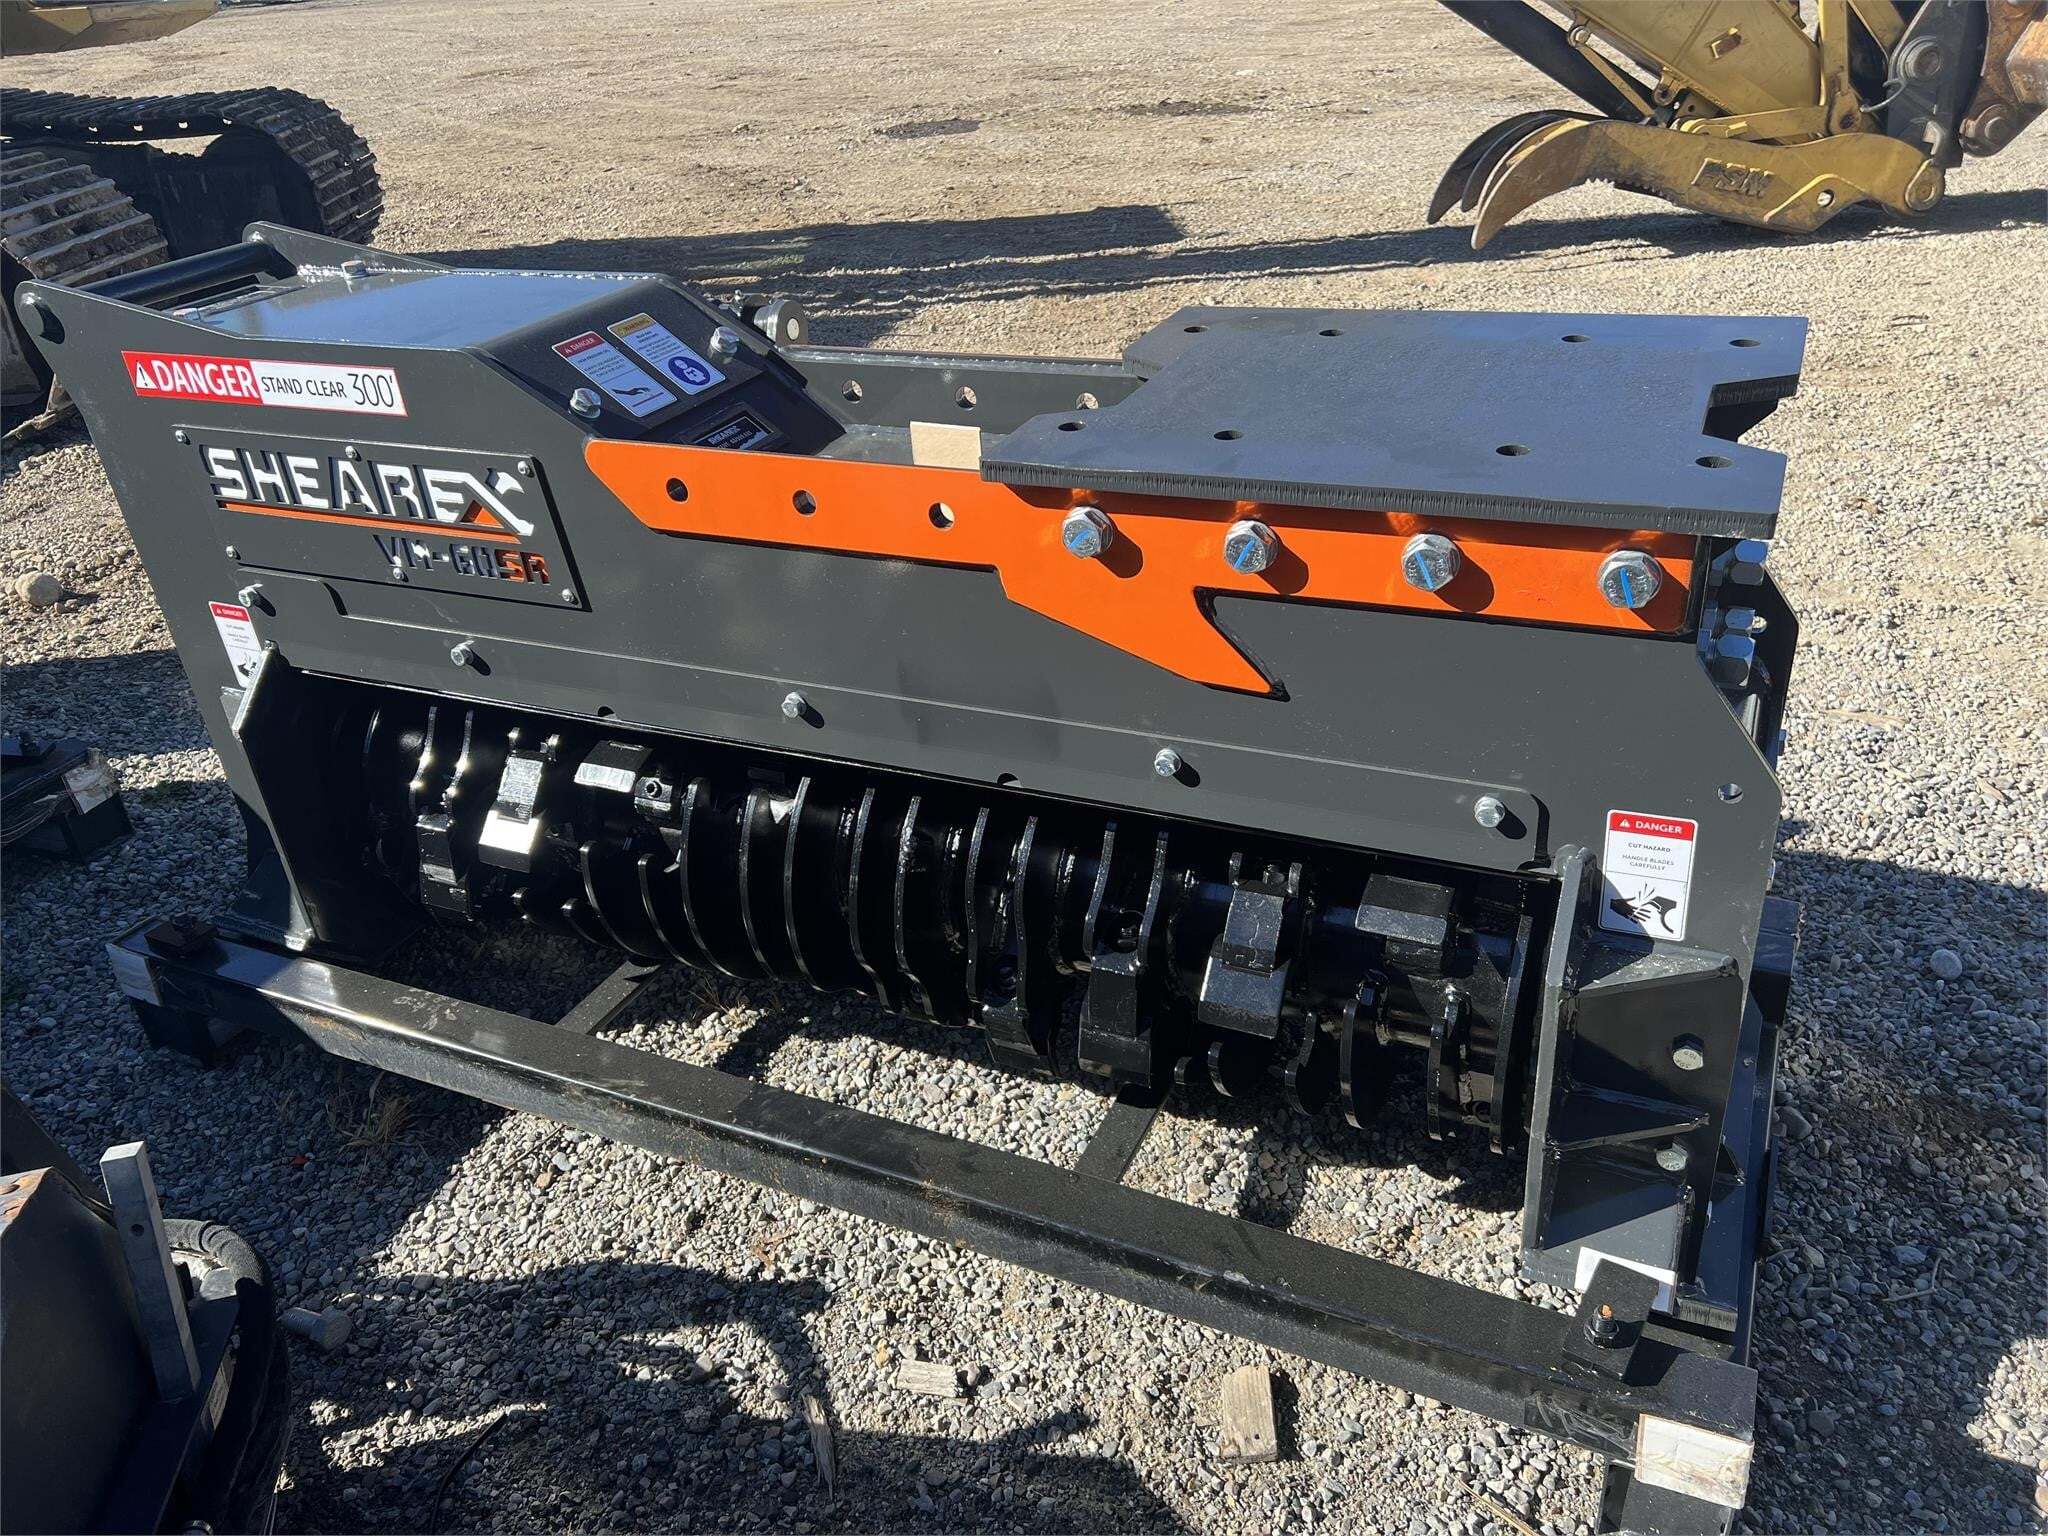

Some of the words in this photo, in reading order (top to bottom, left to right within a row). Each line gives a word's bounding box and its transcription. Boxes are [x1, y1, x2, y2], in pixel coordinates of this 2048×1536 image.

[154, 360, 259, 399] DANGER
[261, 376, 303, 398] STAND
[305, 380, 347, 399] CLEAR
[200, 445, 534, 536] SHEAREX
[1635, 821, 1682, 834] DANGER
[1643, 844, 1671, 853] HAZARD
